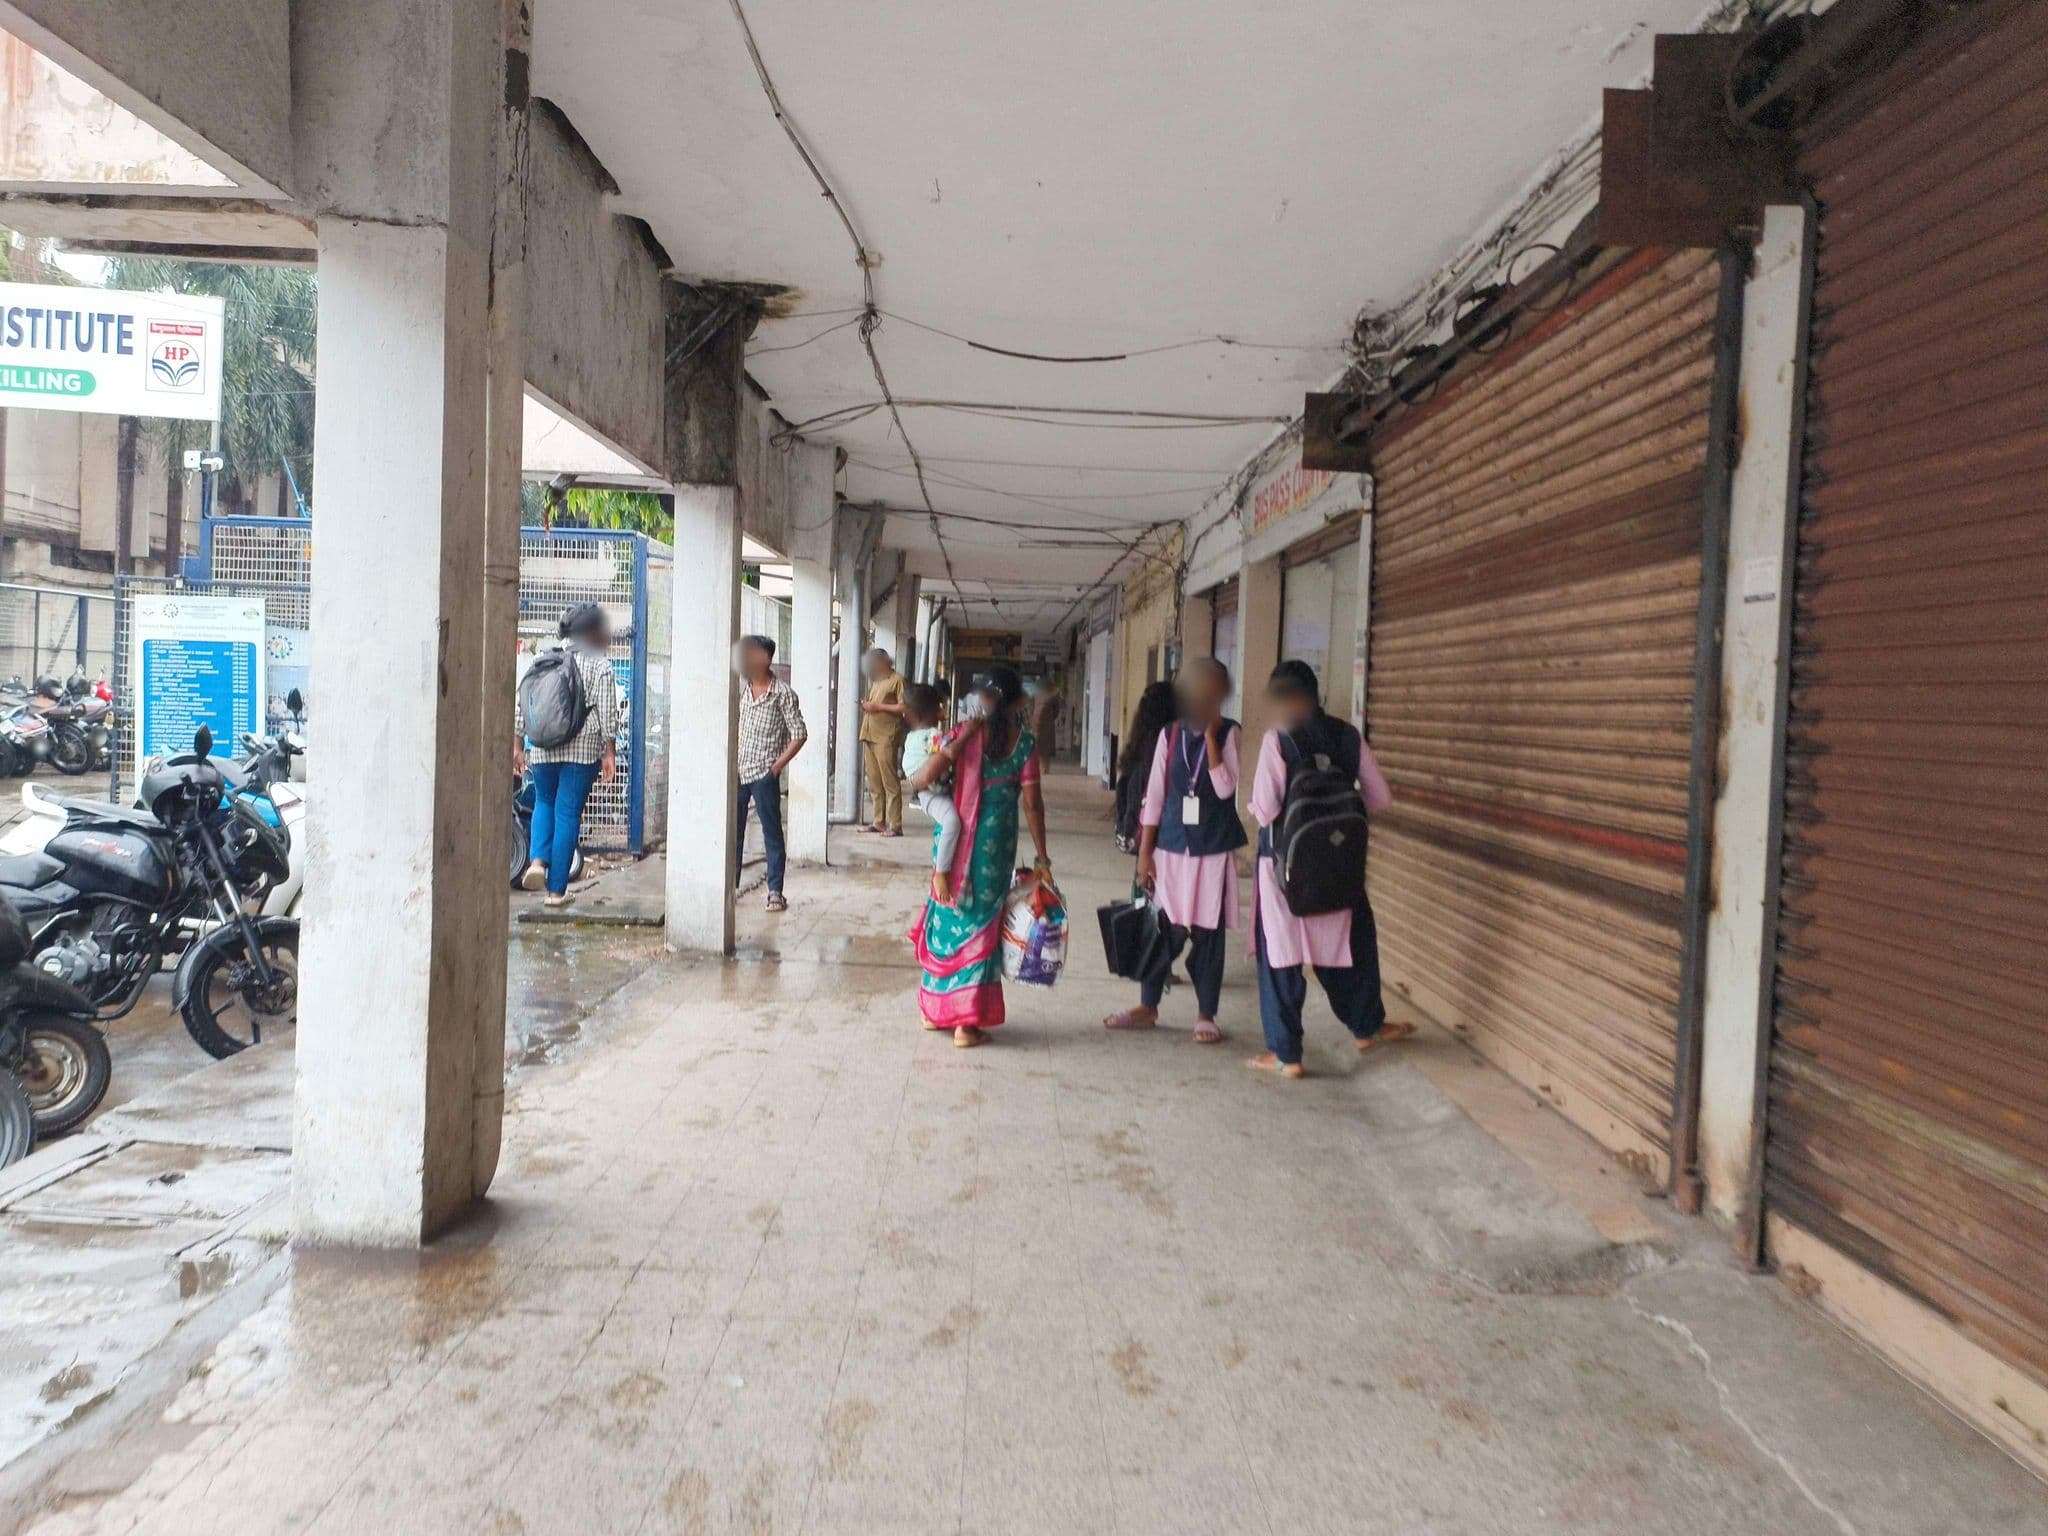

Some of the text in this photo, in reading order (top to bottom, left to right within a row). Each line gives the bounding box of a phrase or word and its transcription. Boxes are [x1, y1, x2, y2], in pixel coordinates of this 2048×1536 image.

[0, 305, 134, 355] STITUTE
[164, 346, 189, 360] HP
[0, 368, 82, 393] ILLING
